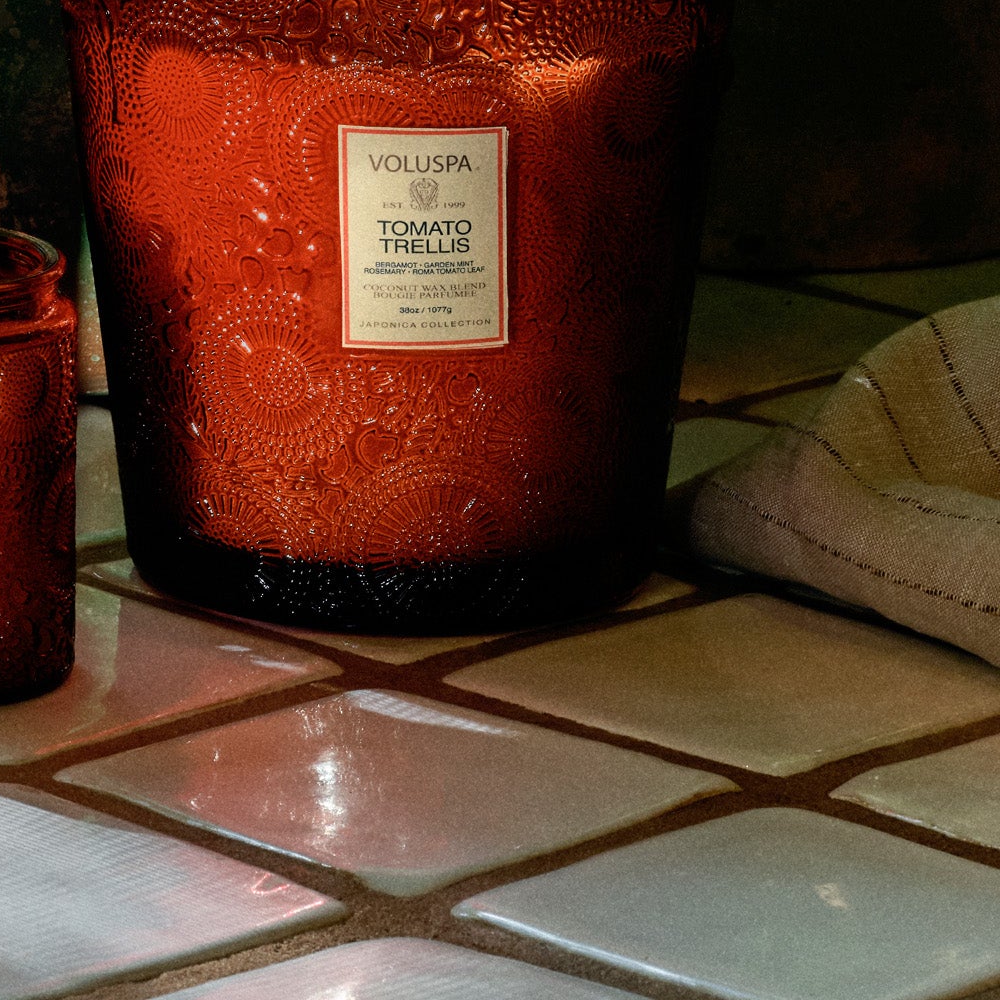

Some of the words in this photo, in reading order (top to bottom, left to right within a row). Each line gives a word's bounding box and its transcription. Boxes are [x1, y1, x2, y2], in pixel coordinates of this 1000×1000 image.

[368, 154, 472, 173] VOLUSPA
[444, 201, 465, 209] 1999
[377, 220, 472, 236] TOMATO
[379, 237, 470, 254] TRELLIS
[467, 266, 485, 274] LEAF
[363, 284, 417, 292] COCONUT
[450, 282, 486, 290] BLEND
[428, 306, 452, 314] 1077g
[359, 321, 417, 329] JAPONICA
[421, 319, 491, 328] COLLECTION
